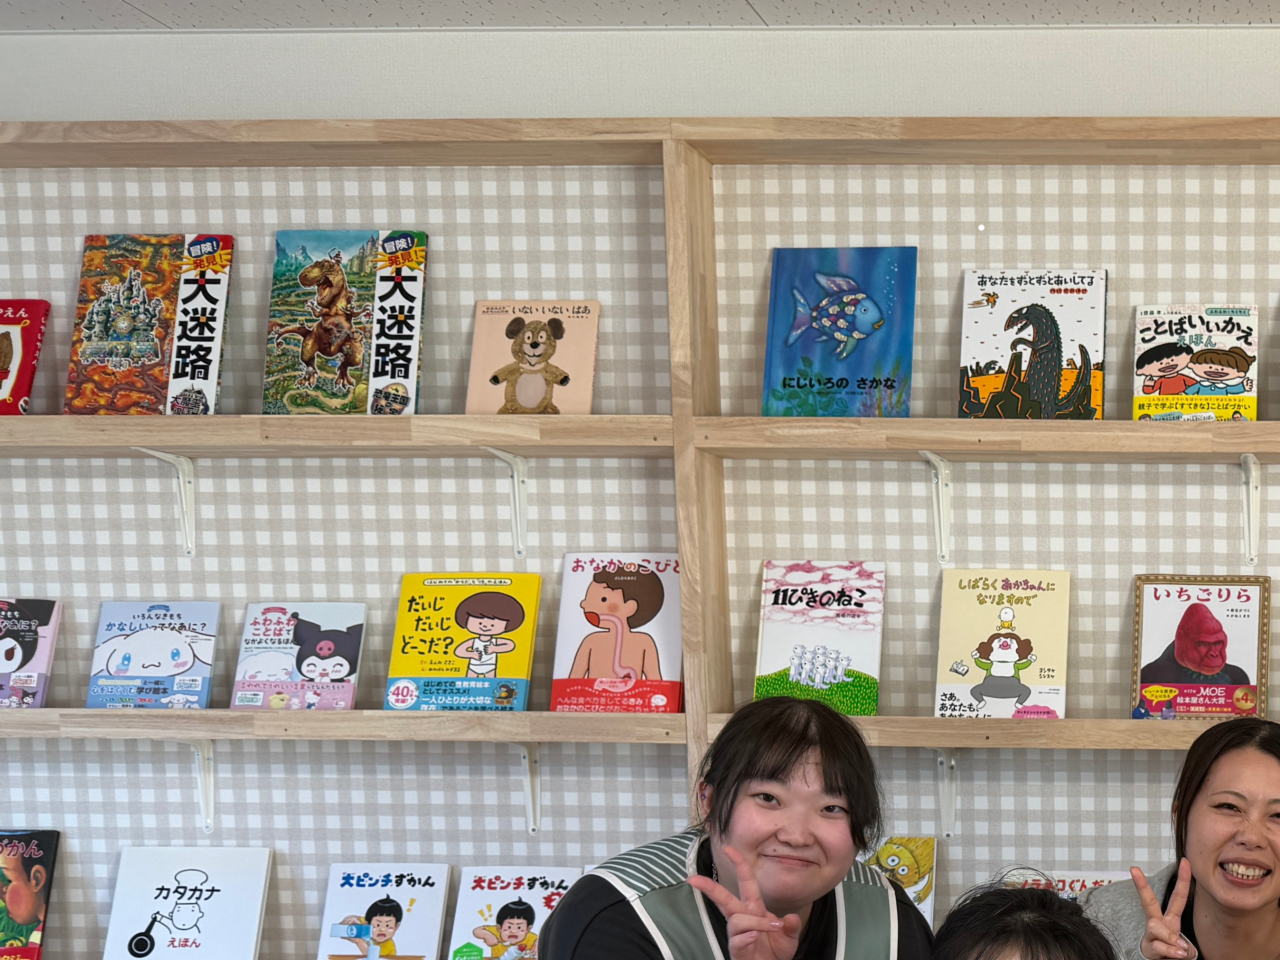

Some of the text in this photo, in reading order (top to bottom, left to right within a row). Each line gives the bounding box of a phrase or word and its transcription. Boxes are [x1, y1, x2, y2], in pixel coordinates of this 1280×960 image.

[977, 274, 1095, 287] あなたをずっとずっとあいしてる
[572, 305, 591, 315] ばあ
[172, 270, 221, 381] 大迷路
[373, 268, 418, 380] 大迷路
[1140, 315, 1254, 346] ことばいいかえ
[1177, 334, 1217, 348] えほん
[782, 377, 897, 390] にじいろの さかな
[958, 577, 1056, 592] しばらく あかちゃんに
[772, 587, 867, 608] 11ぴきのねこ
[976, 593, 1038, 606] なりますので
[1153, 587, 1252, 603] いちごりら
[407, 595, 445, 613] だいじ
[250, 616, 297, 627] ふわふわ
[415, 616, 452, 632] だいじ
[252, 626, 292, 637] ことばで
[392, 686, 410, 698] 40
[1196, 686, 1226, 697] MOE
[421, 696, 492, 704] 一人ひとりが大切な
[340, 872, 436, 888] 大ピンチずかん
[471, 875, 569, 891] 大ピンチずかん
[154, 885, 221, 901] カタカナ
[167, 937, 201, 948] えほん
